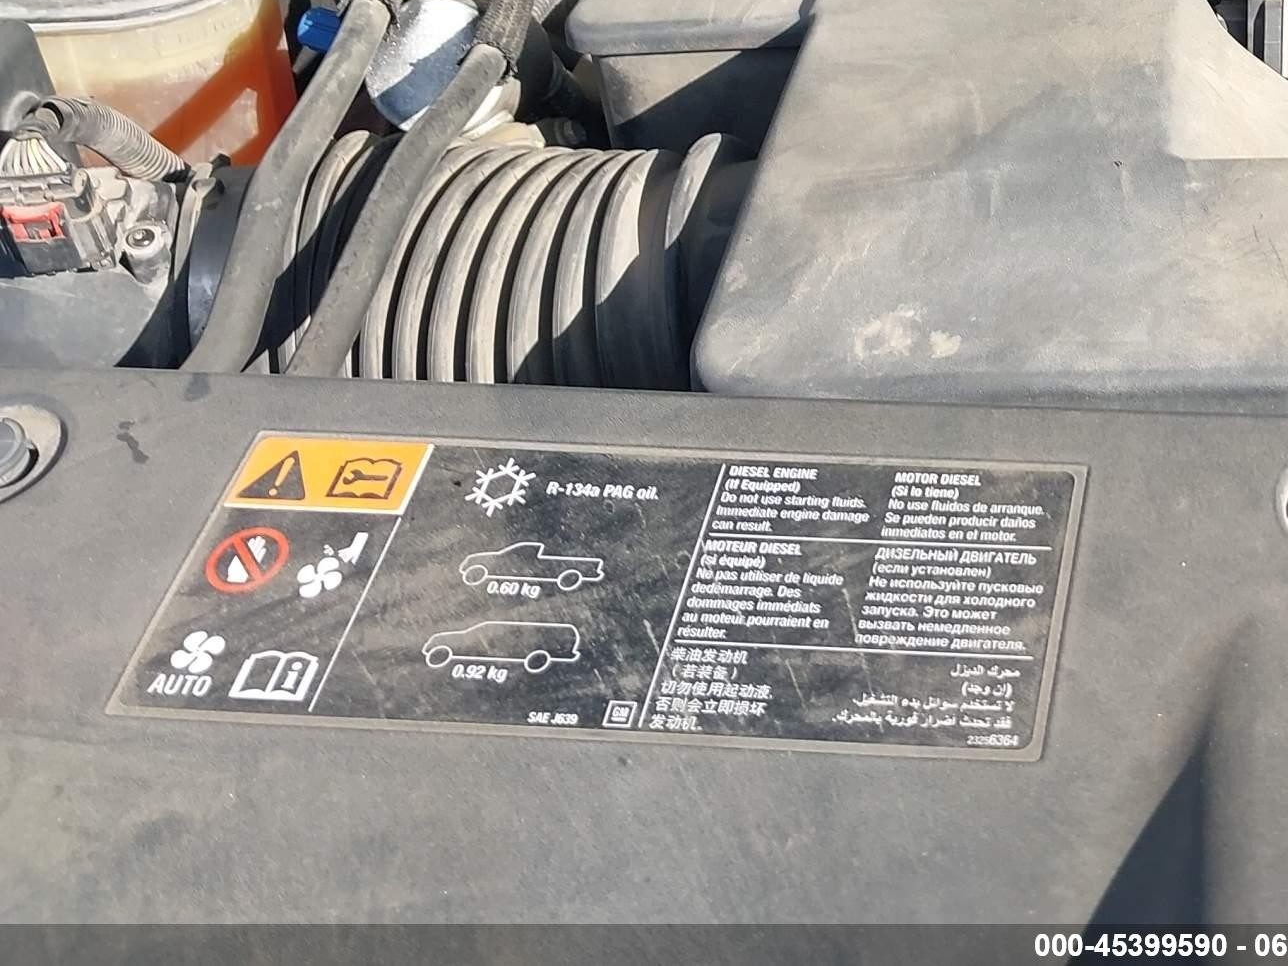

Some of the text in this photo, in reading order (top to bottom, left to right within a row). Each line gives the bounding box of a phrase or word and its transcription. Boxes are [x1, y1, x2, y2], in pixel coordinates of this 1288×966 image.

[729, 465, 818, 480] DIESEL ENGINE
[894, 472, 981, 486] MOTOR DIESEL
[546, 481, 659, 500] R-134a PAG oil.
[725, 478, 801, 494] (If Equipped)
[891, 485, 959, 500] (Si lo tiene)
[720, 491, 867, 509] Do not use starting fluids.
[888, 498, 1044, 517] No use fluidos de arranque.
[716, 505, 870, 524] Immediate engine damage
[884, 512, 1036, 529] Se pueden producir daños
[712, 520, 773, 532] can result.
[881, 525, 1016, 542] inmediatos en el motor.
[705, 539, 802, 555] MOTEUR DIESEL
[701, 554, 766, 569] (si équipé)
[875, 547, 1037, 565] ДИЗЕЛЬНЫЙ ДВИГАТЕЛЬ
[696, 567, 844, 586] Ne pas utiliser de liquide
[872, 562, 992, 579] (если установлен)
[487, 580, 541, 598] 0.60 kg
[777, 585, 802, 598] Des
[869, 575, 1044, 594] Не используйте пусковые
[686, 596, 822, 613] dommages immédiats
[865, 591, 1036, 609] жидкости для холодного
[681, 612, 830, 629] au moteur pourraient en
[861, 605, 997, 620] запуска. Это может
[677, 624, 727, 639] résulter.
[858, 620, 1011, 635] вызвать немедленное
[854, 633, 1027, 651] повреждение двигателя.
[670, 647, 748, 665] 柴油发动机
[451, 664, 508, 682] 0.92 kg
[147, 673, 213, 697] AUTO
[655, 696, 768, 717] 否则会立即损坏
[527, 711, 579, 725] SAE J639
